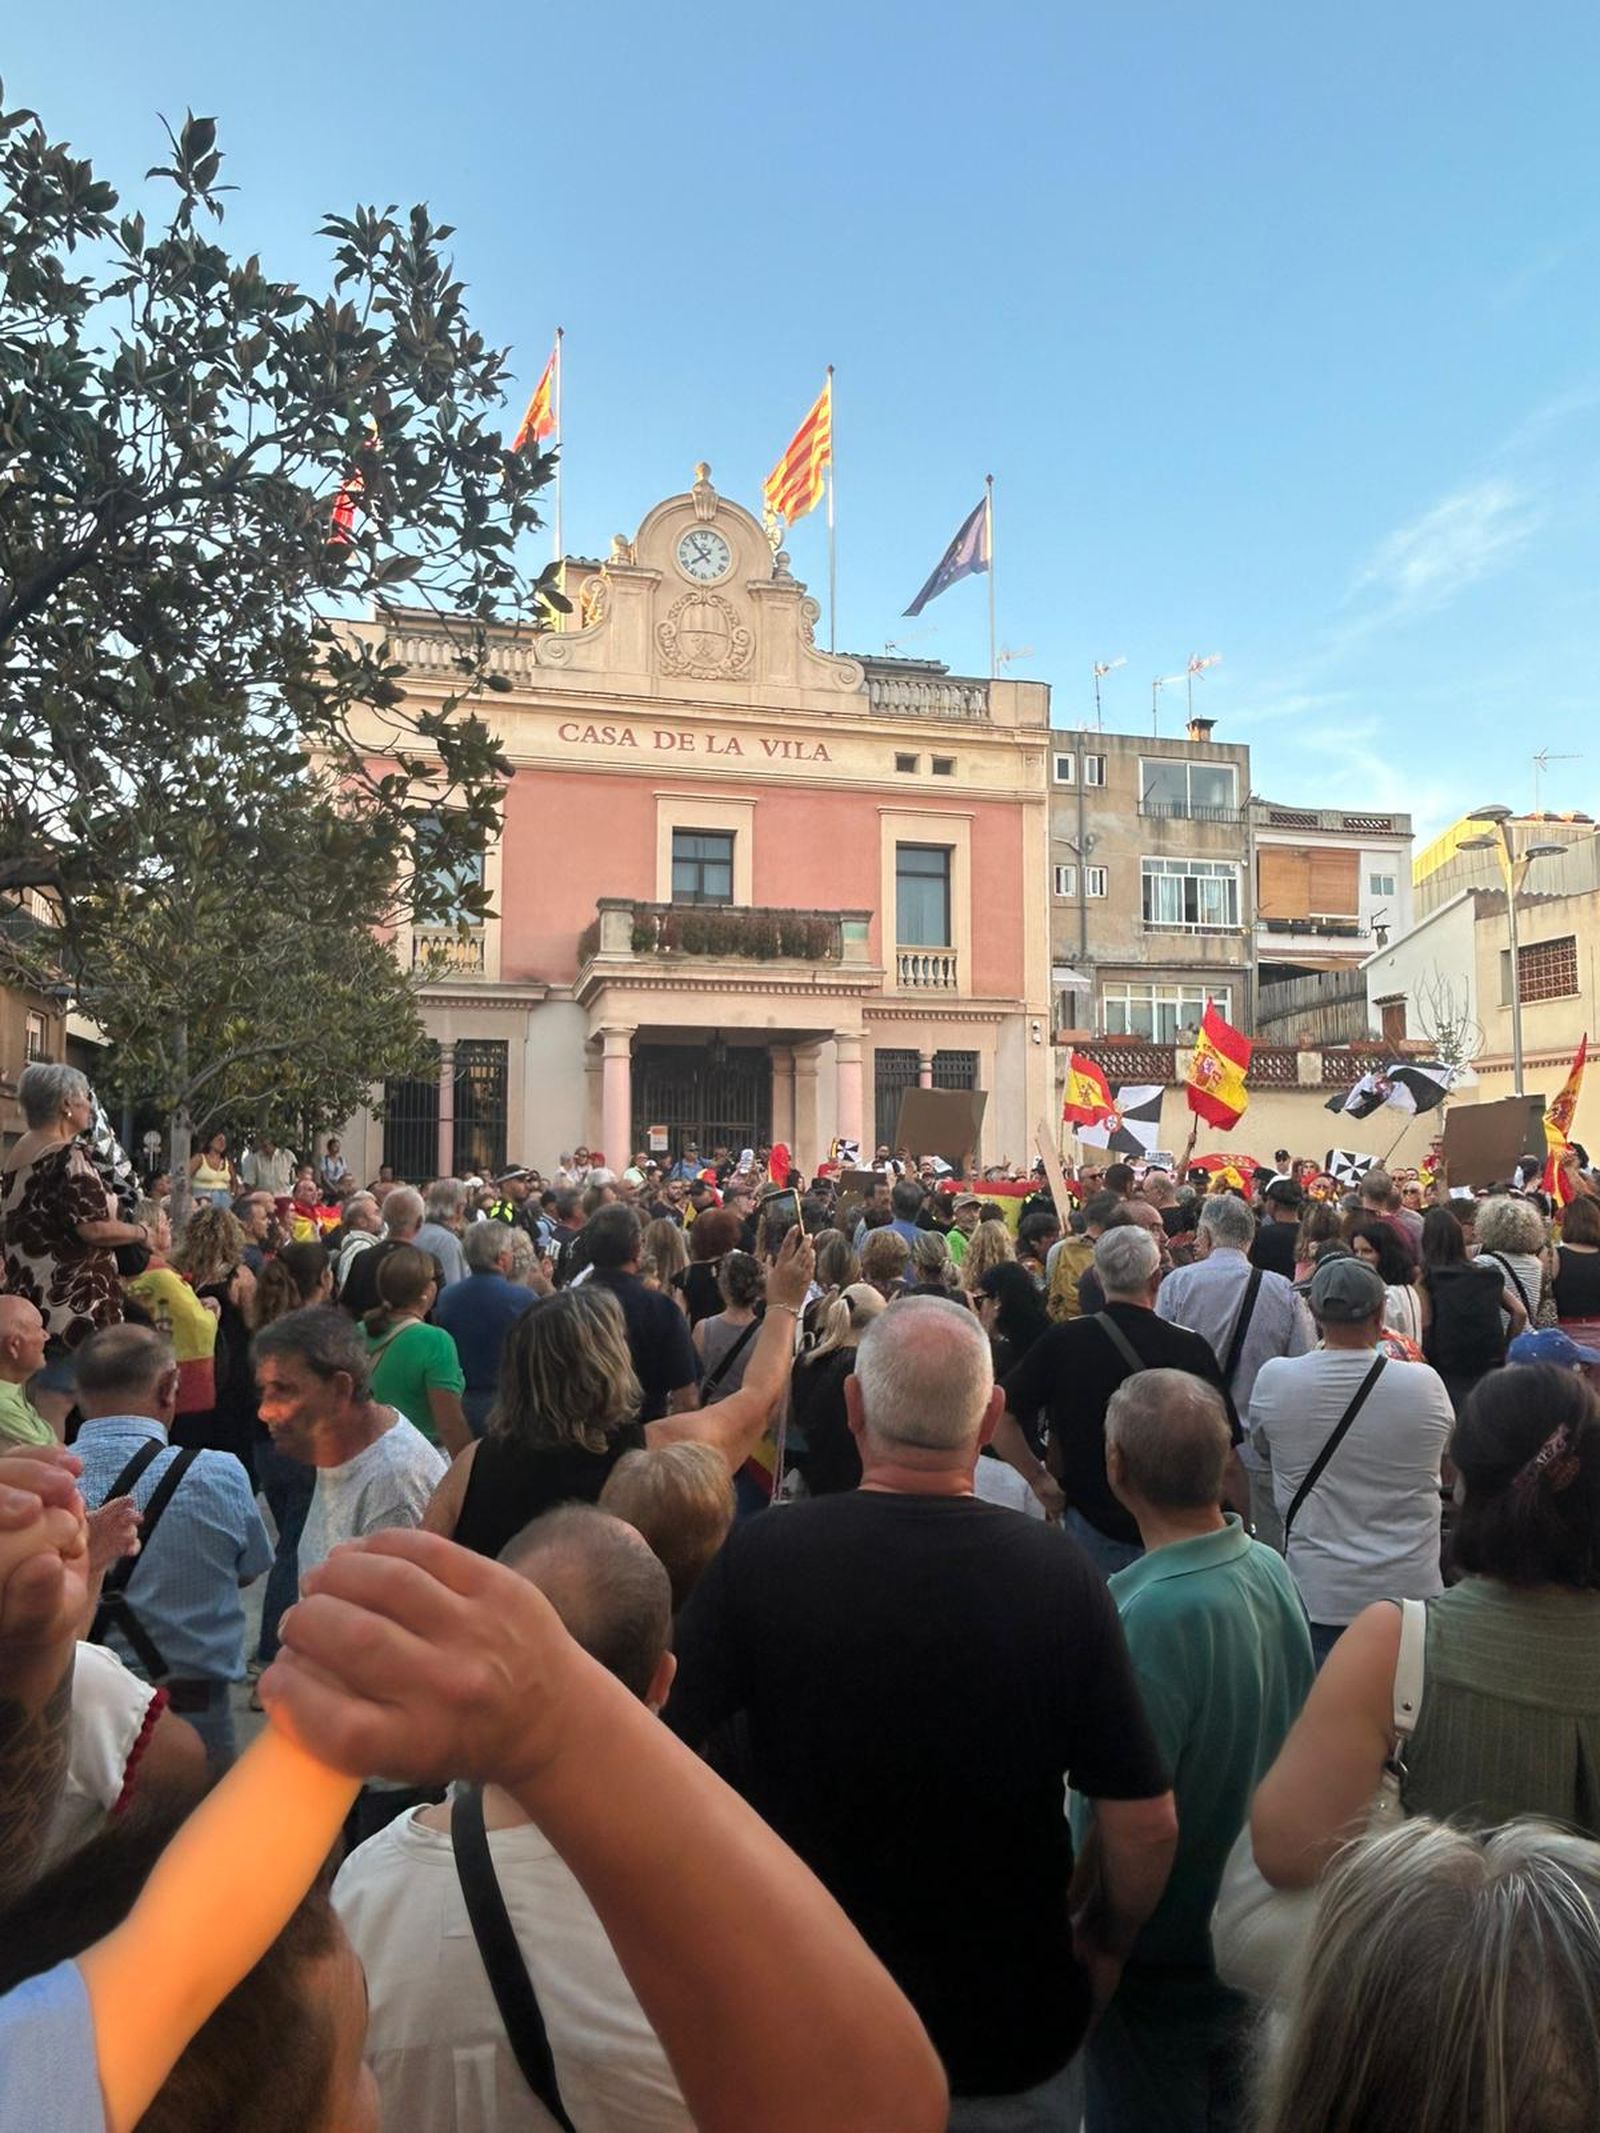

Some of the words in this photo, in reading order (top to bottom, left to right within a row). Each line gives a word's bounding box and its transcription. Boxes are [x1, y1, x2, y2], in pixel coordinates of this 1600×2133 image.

[558, 723, 638, 747] CASA
[653, 730, 696, 751] DE
[706, 735, 745, 756] LA
[759, 738, 832, 762] VILA
